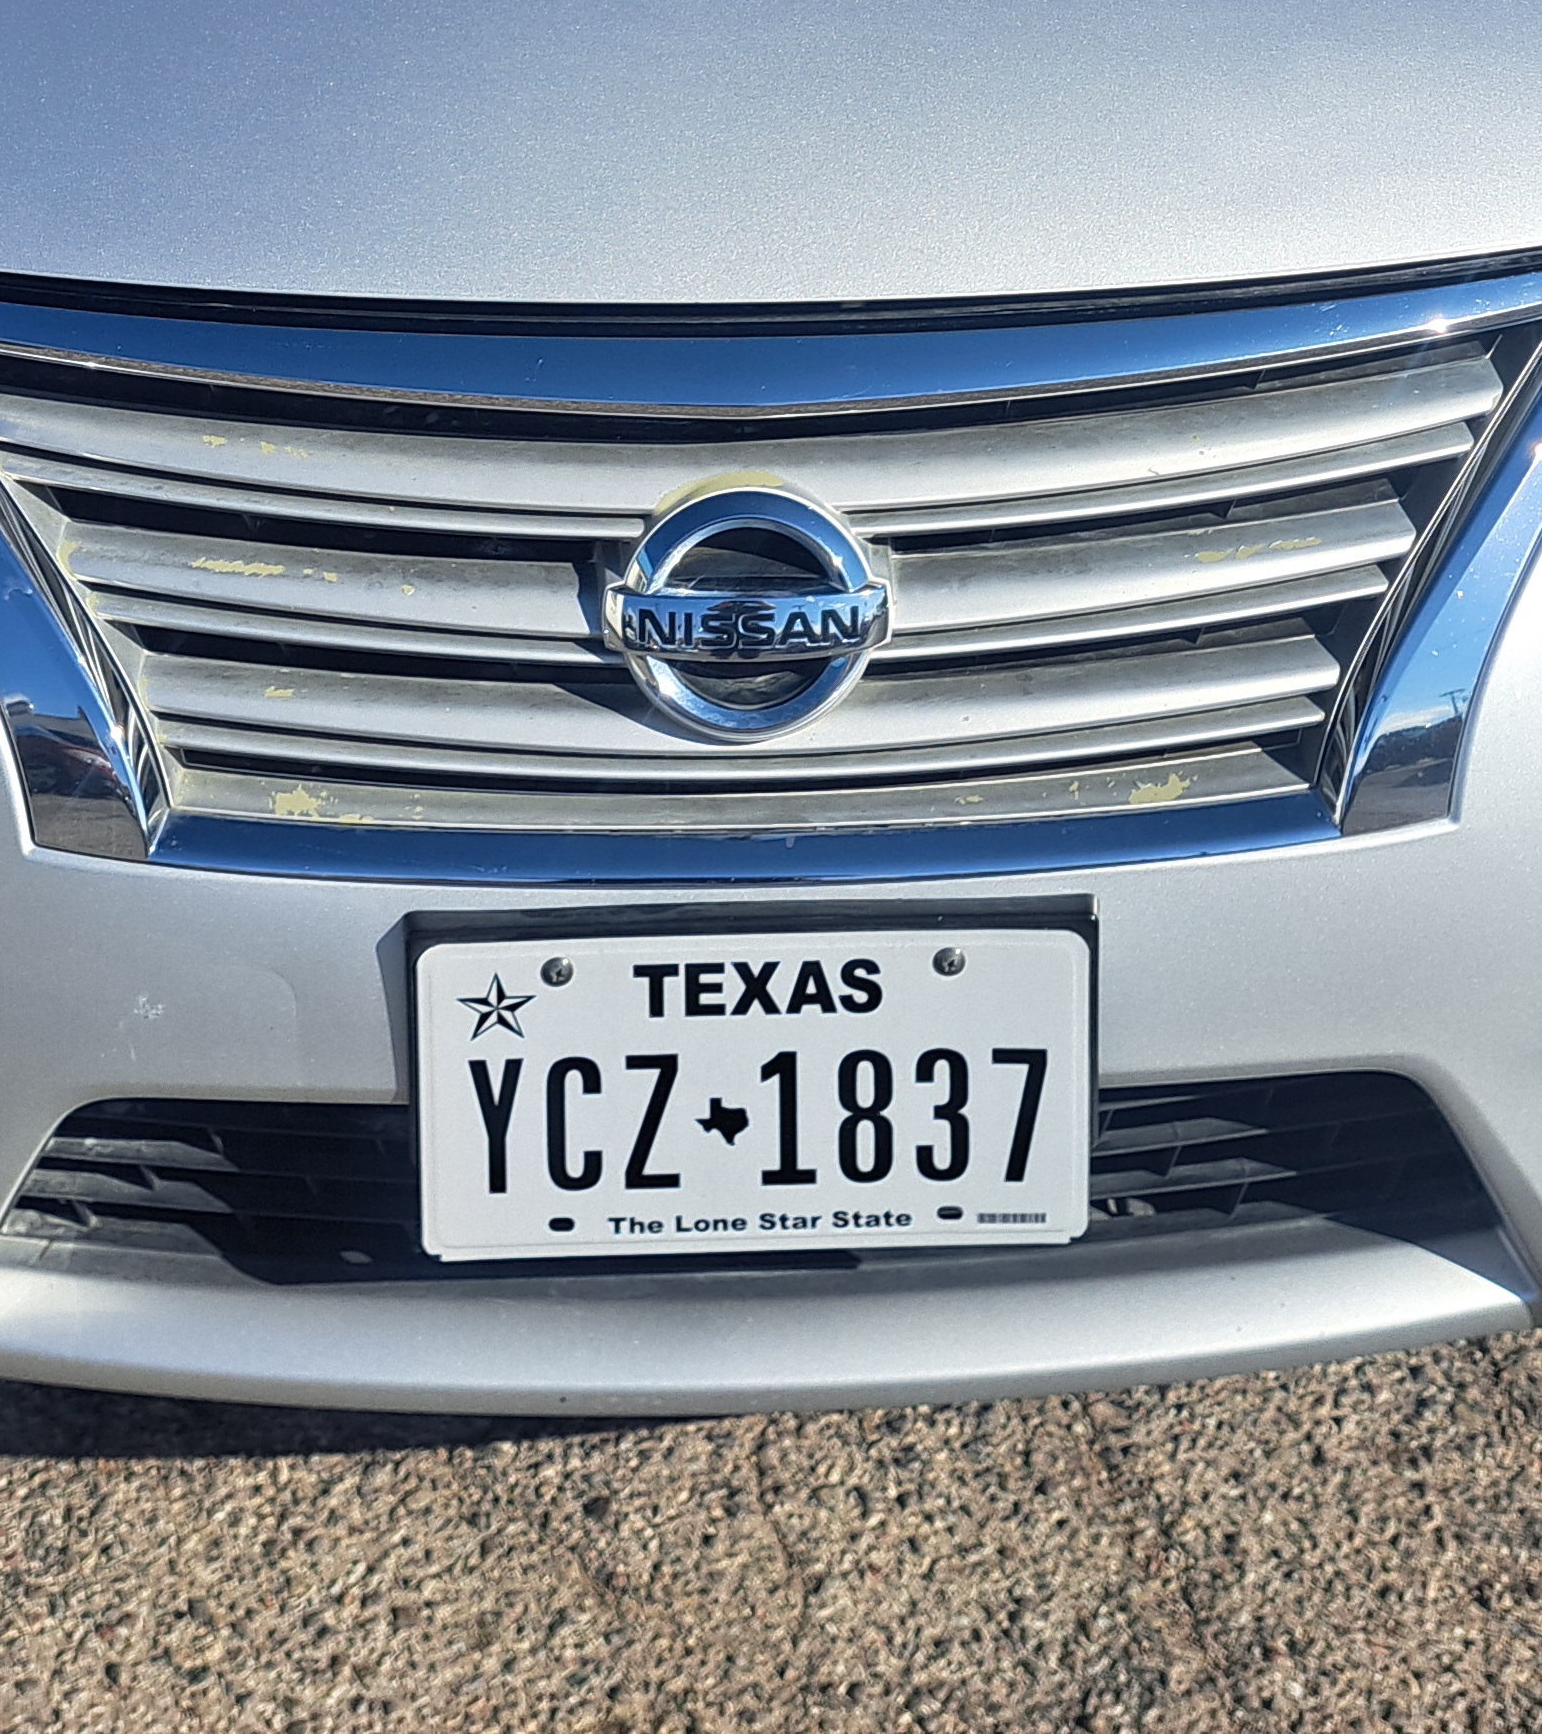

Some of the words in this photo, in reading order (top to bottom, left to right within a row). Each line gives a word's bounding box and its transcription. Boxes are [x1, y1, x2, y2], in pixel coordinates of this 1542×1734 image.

[637, 605, 861, 651] NISSAN
[633, 958, 884, 1018] TEXAS
[468, 1053, 681, 1194] YCZ
[760, 1048, 1049, 1186] 1837
[608, 1216, 665, 1235] The
[674, 1213, 749, 1233] Lone
[758, 1211, 822, 1231] Star
[831, 1209, 913, 1229] State
